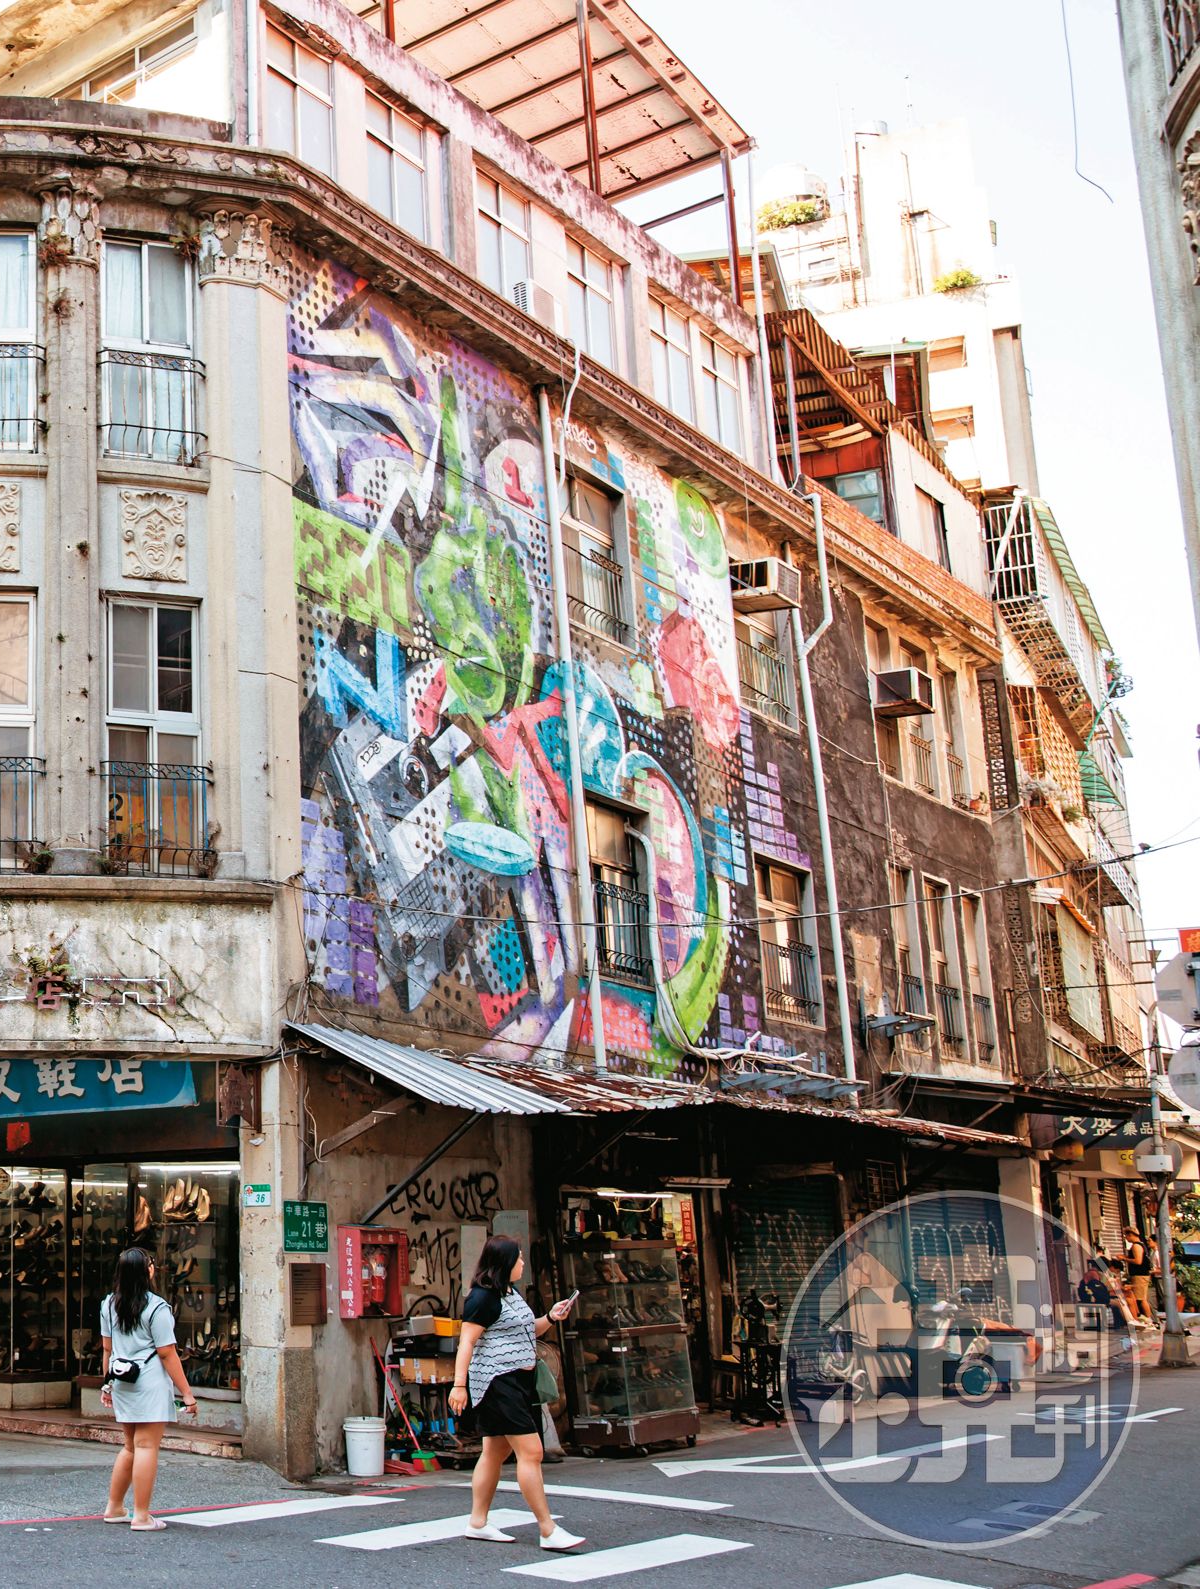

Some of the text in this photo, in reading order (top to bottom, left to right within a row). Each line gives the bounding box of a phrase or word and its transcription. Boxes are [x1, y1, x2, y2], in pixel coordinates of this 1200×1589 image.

[256, 1193, 266, 1203] 36
[285, 1204, 326, 1218] 中華路一段
[287, 1229, 299, 1237] Lane
